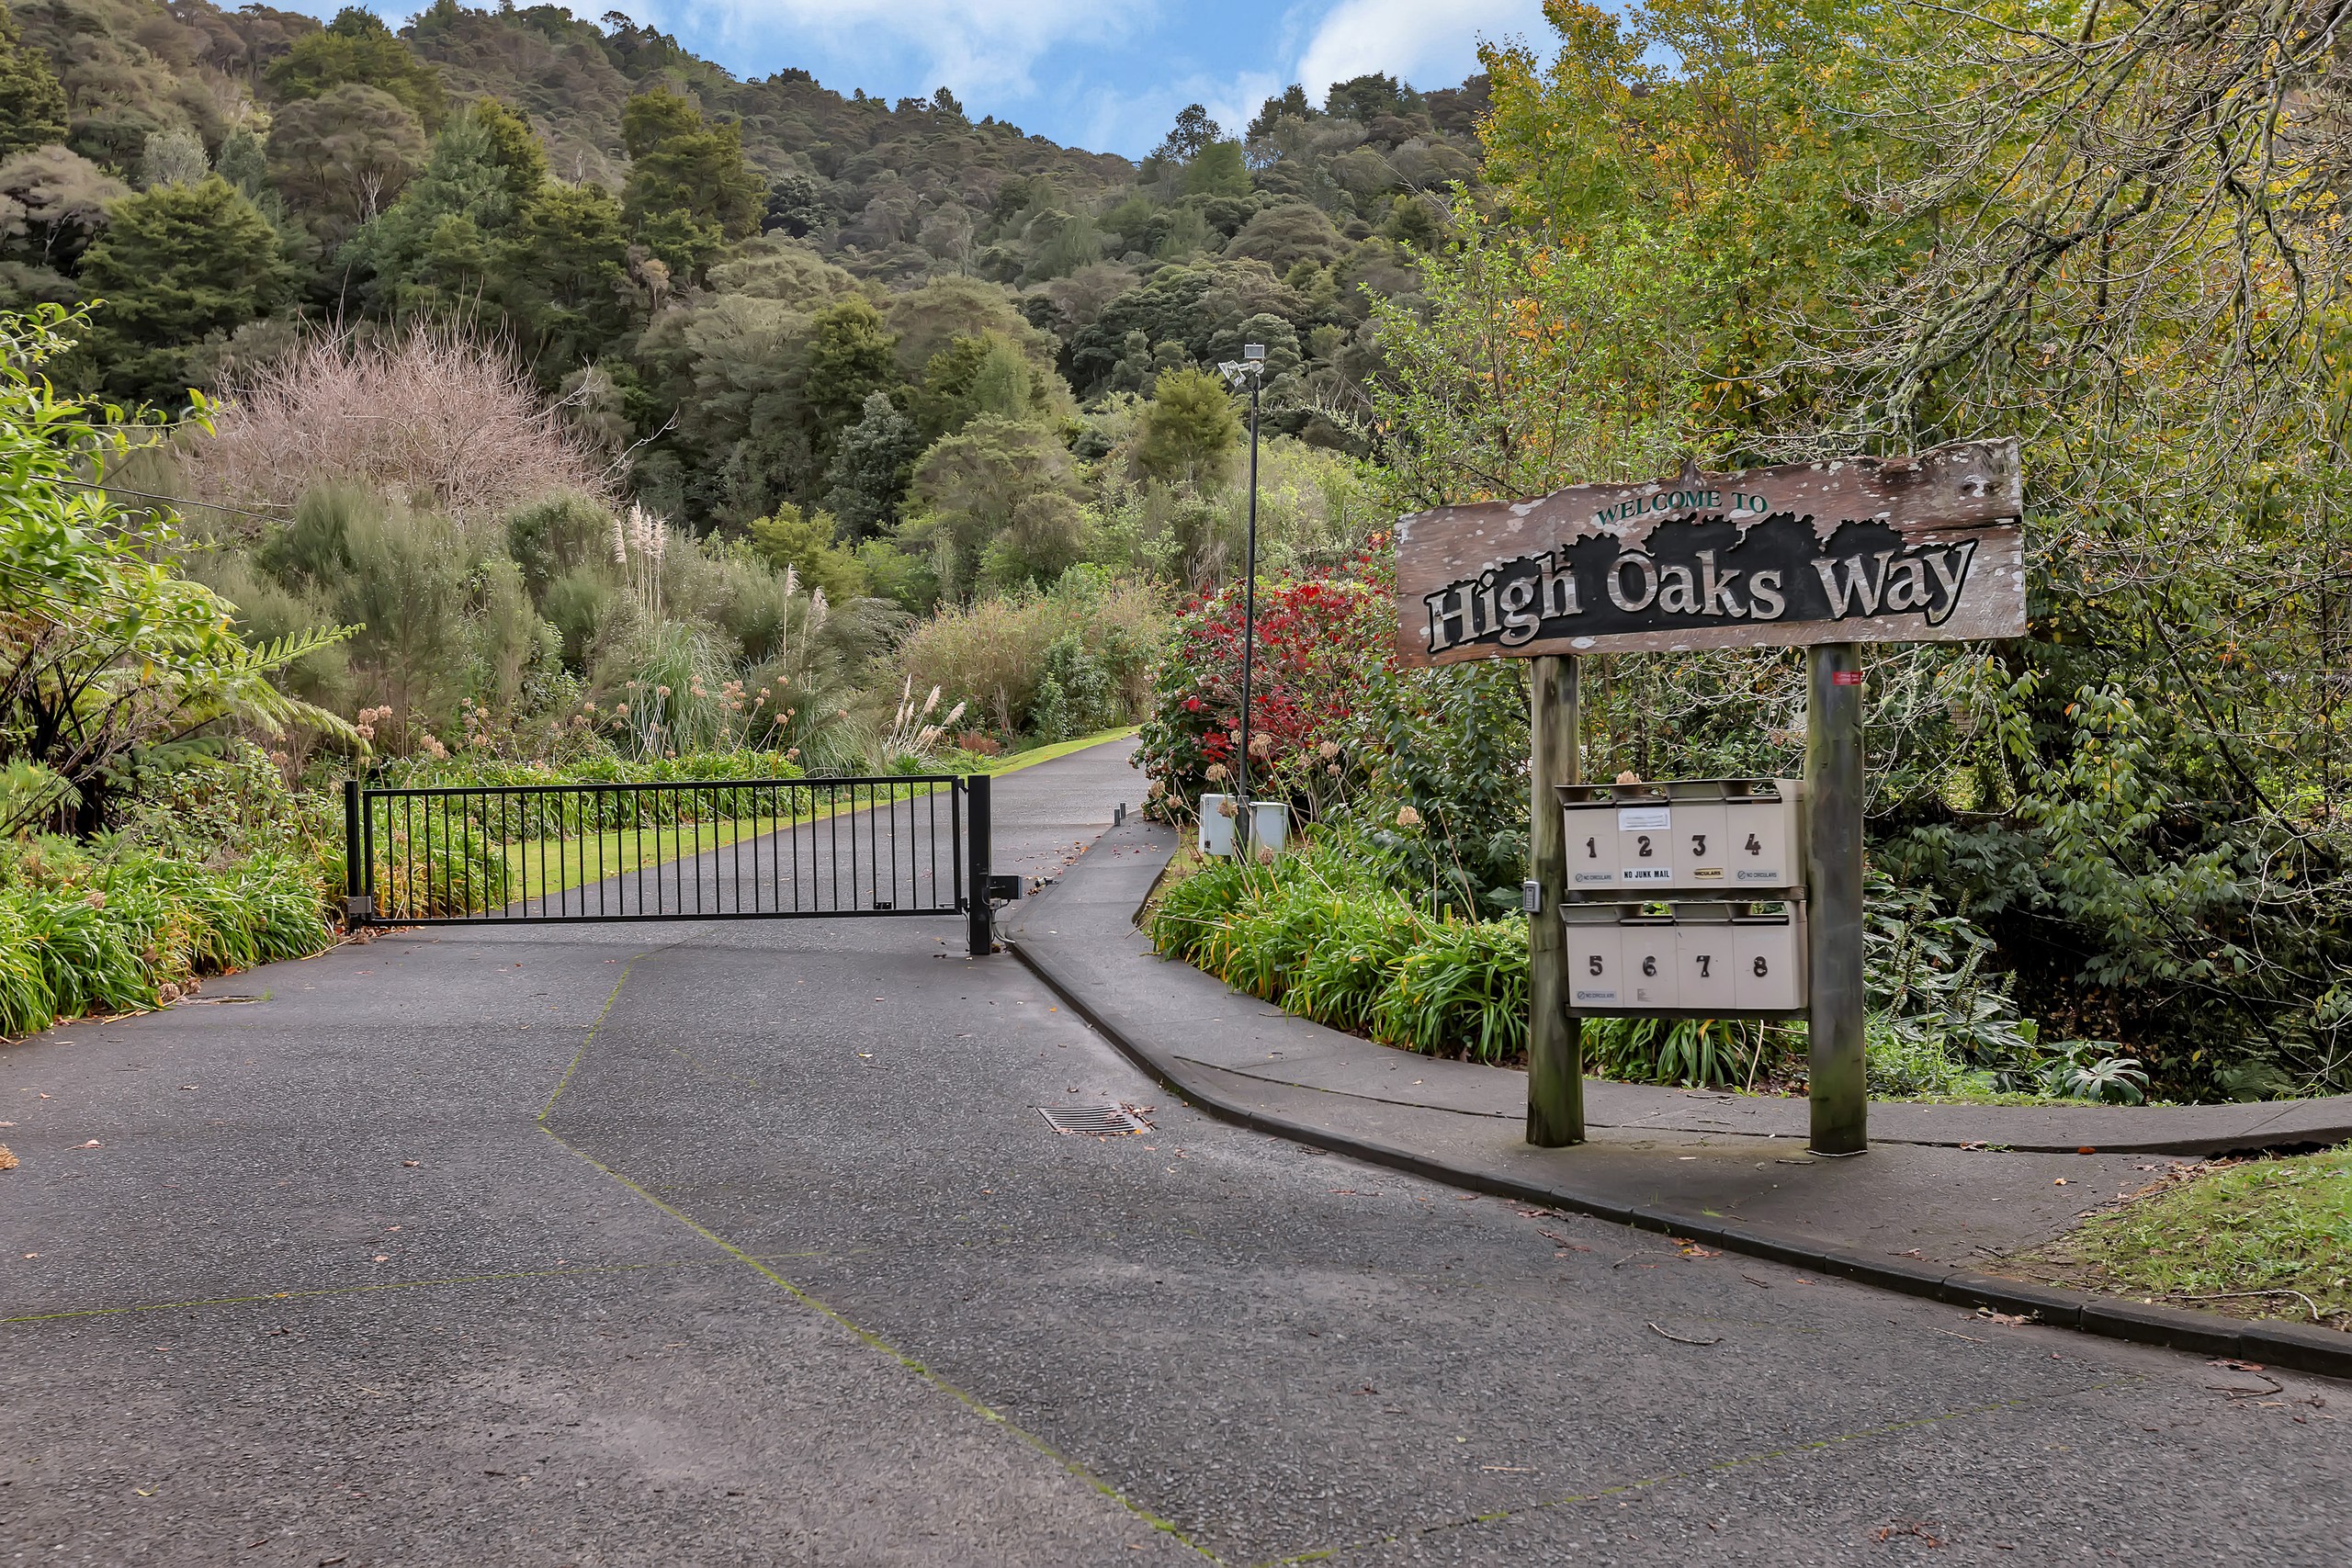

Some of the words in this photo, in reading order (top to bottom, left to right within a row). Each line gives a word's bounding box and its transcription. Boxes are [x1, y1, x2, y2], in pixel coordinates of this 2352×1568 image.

[1597, 491, 1723, 525] WELCOME
[1731, 491, 1768, 513] TO
[1427, 553, 1582, 652] High
[1607, 550, 1786, 620] Oaks
[1811, 539, 1977, 625] Way
[1586, 837, 1597, 858] 1
[1637, 835, 1653, 857] 2
[1691, 834, 1706, 856] 3
[1745, 833, 1761, 855] 4
[1623, 871, 1633, 879] NO
[1654, 870, 1670, 878] MAIL
[1589, 954, 1603, 976] 5
[1643, 955, 1657, 977] 6
[1696, 954, 1711, 977] 7
[1753, 955, 1768, 977] 8
